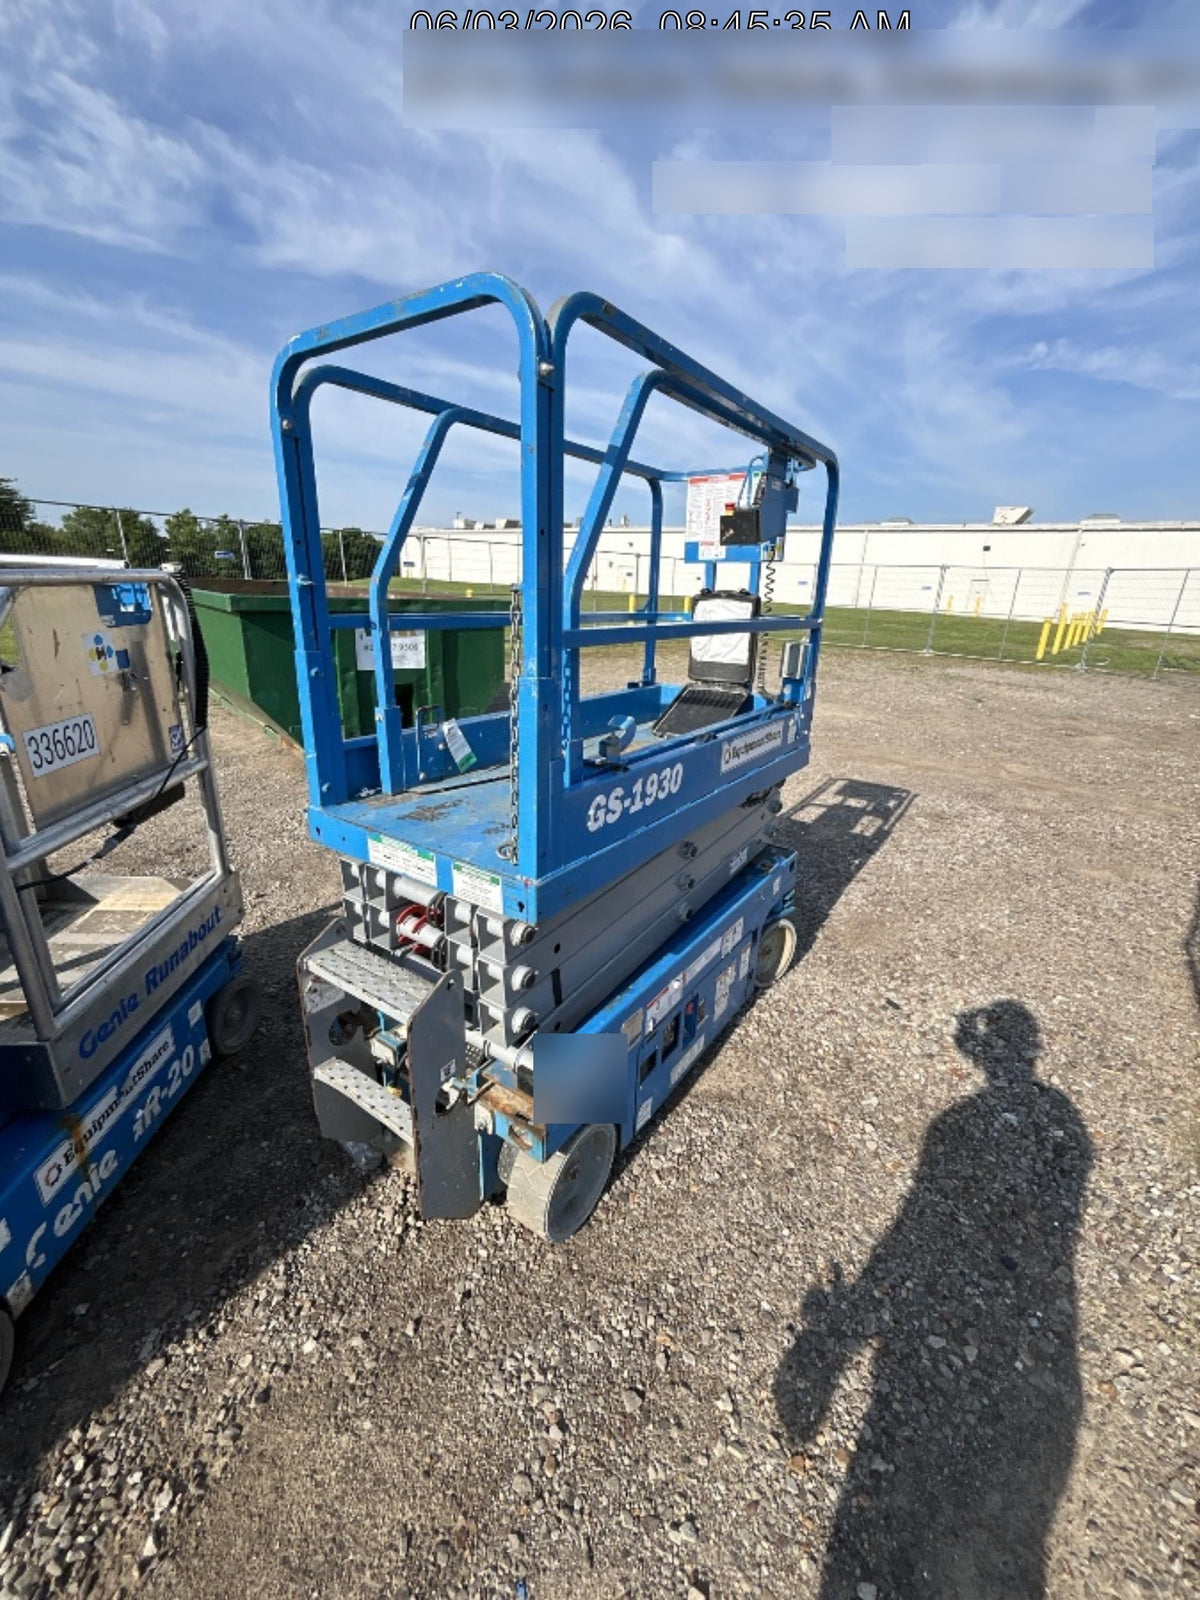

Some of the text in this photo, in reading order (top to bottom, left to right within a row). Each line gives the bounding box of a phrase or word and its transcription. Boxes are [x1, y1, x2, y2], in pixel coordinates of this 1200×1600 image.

[27, 719, 95, 769] 336620
[586, 762, 684, 832] GS-1930
[78, 905, 222, 1059] Genie Runabout
[62, 1041, 170, 1167] EquipmtShare
